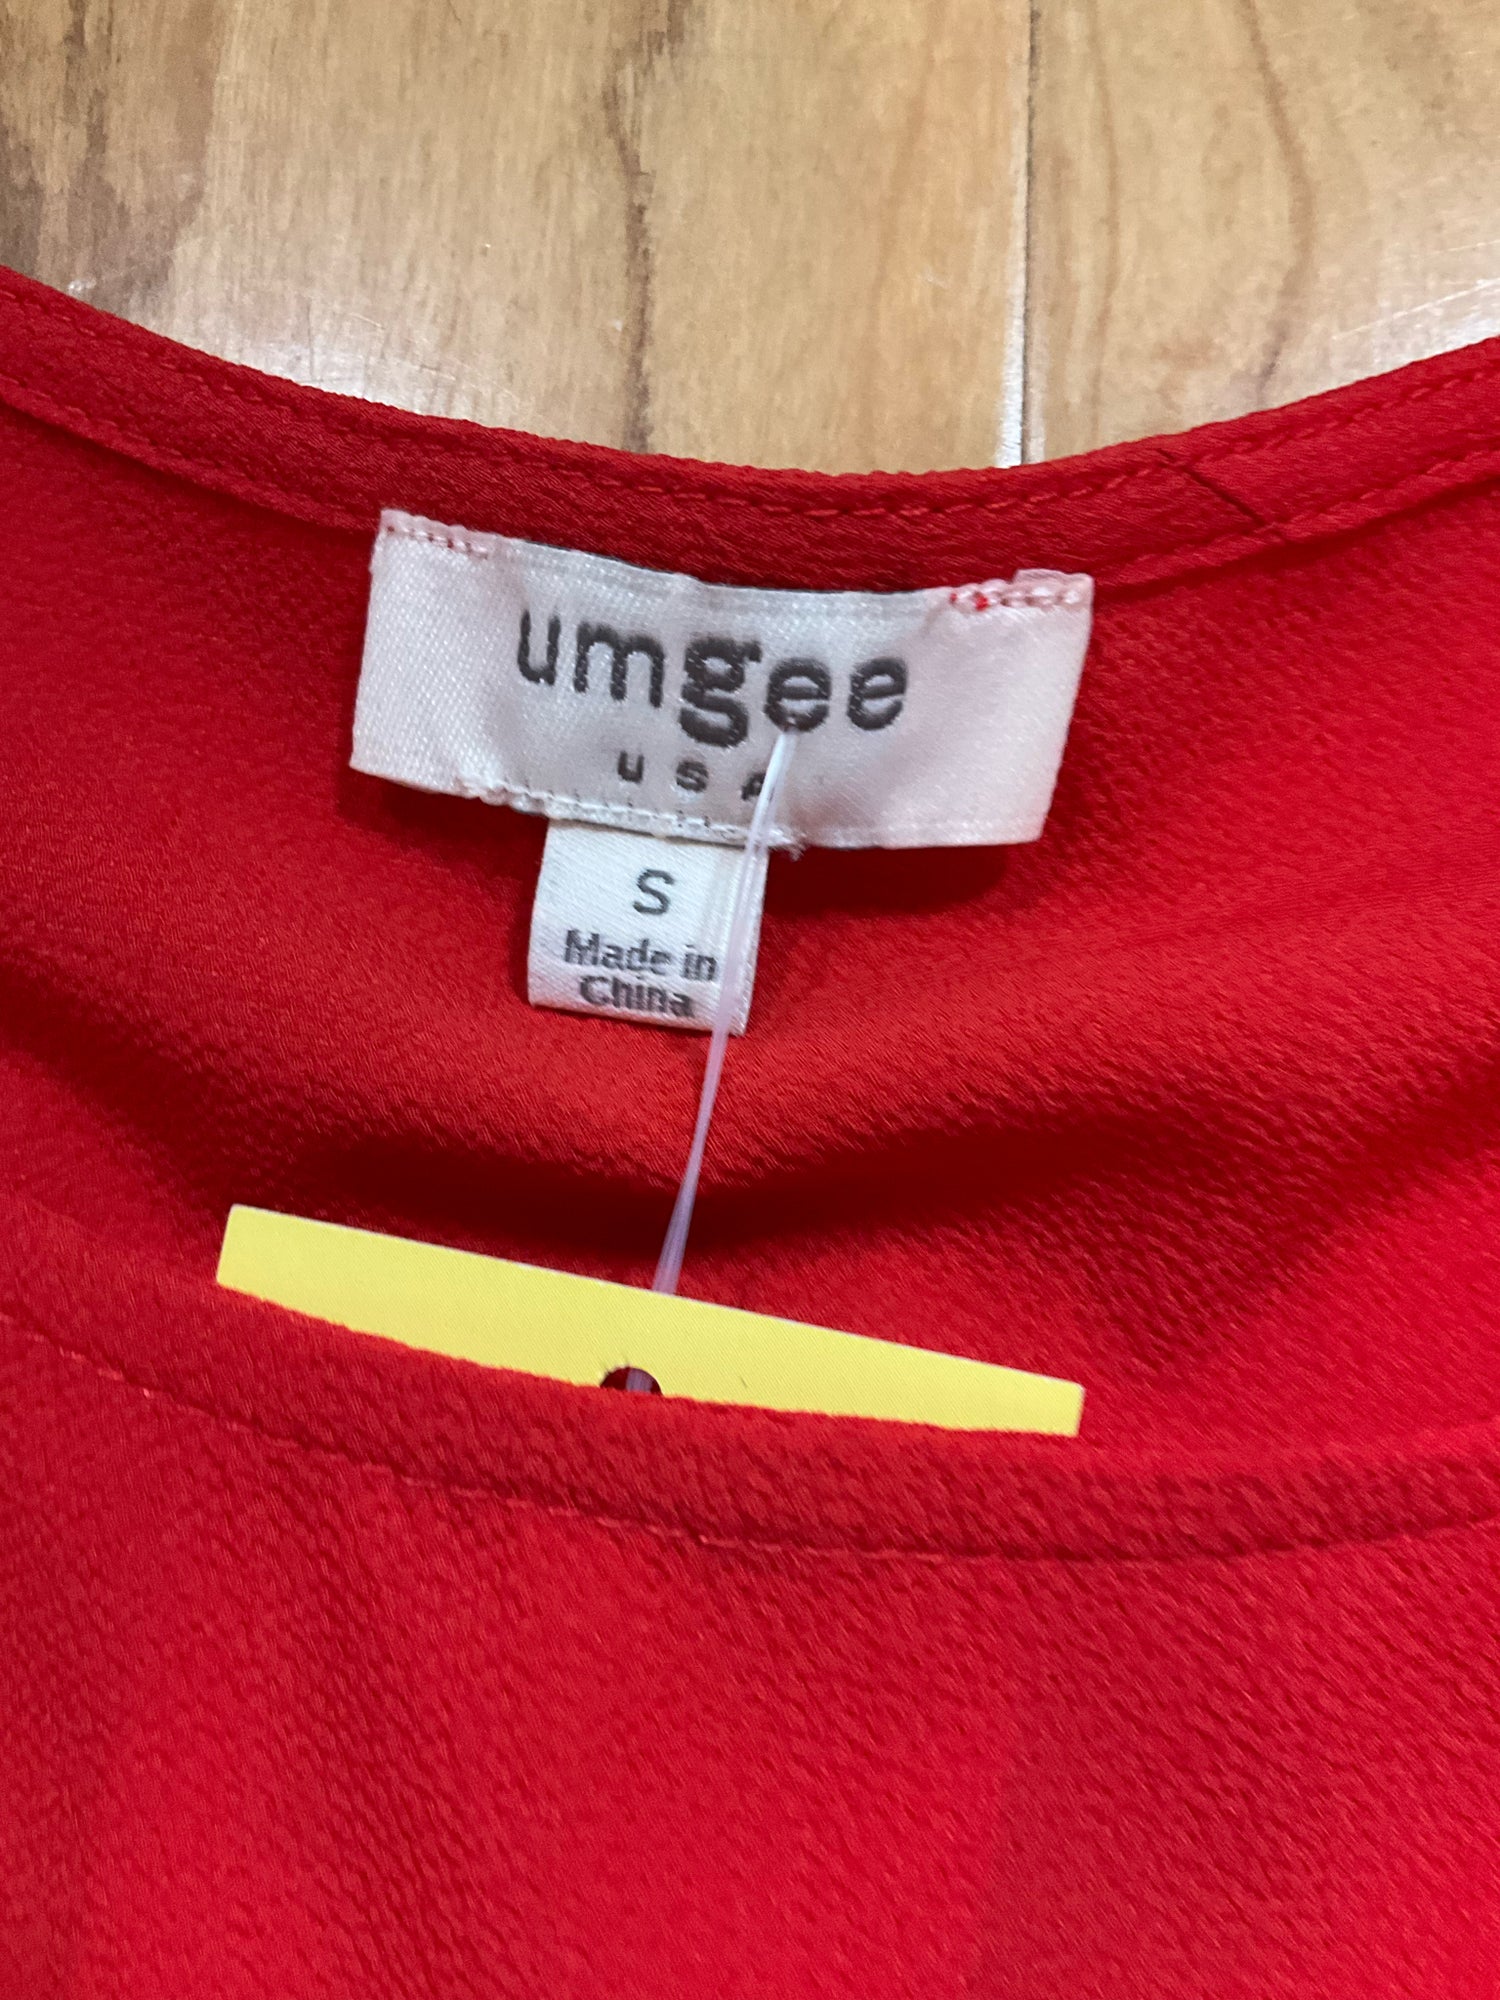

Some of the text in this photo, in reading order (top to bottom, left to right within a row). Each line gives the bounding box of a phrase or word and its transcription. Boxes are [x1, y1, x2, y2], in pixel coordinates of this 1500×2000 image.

[516, 609, 908, 748] umgee
[632, 868, 675, 916] S
[563, 928, 718, 982] Made in
[579, 974, 695, 1018] China
